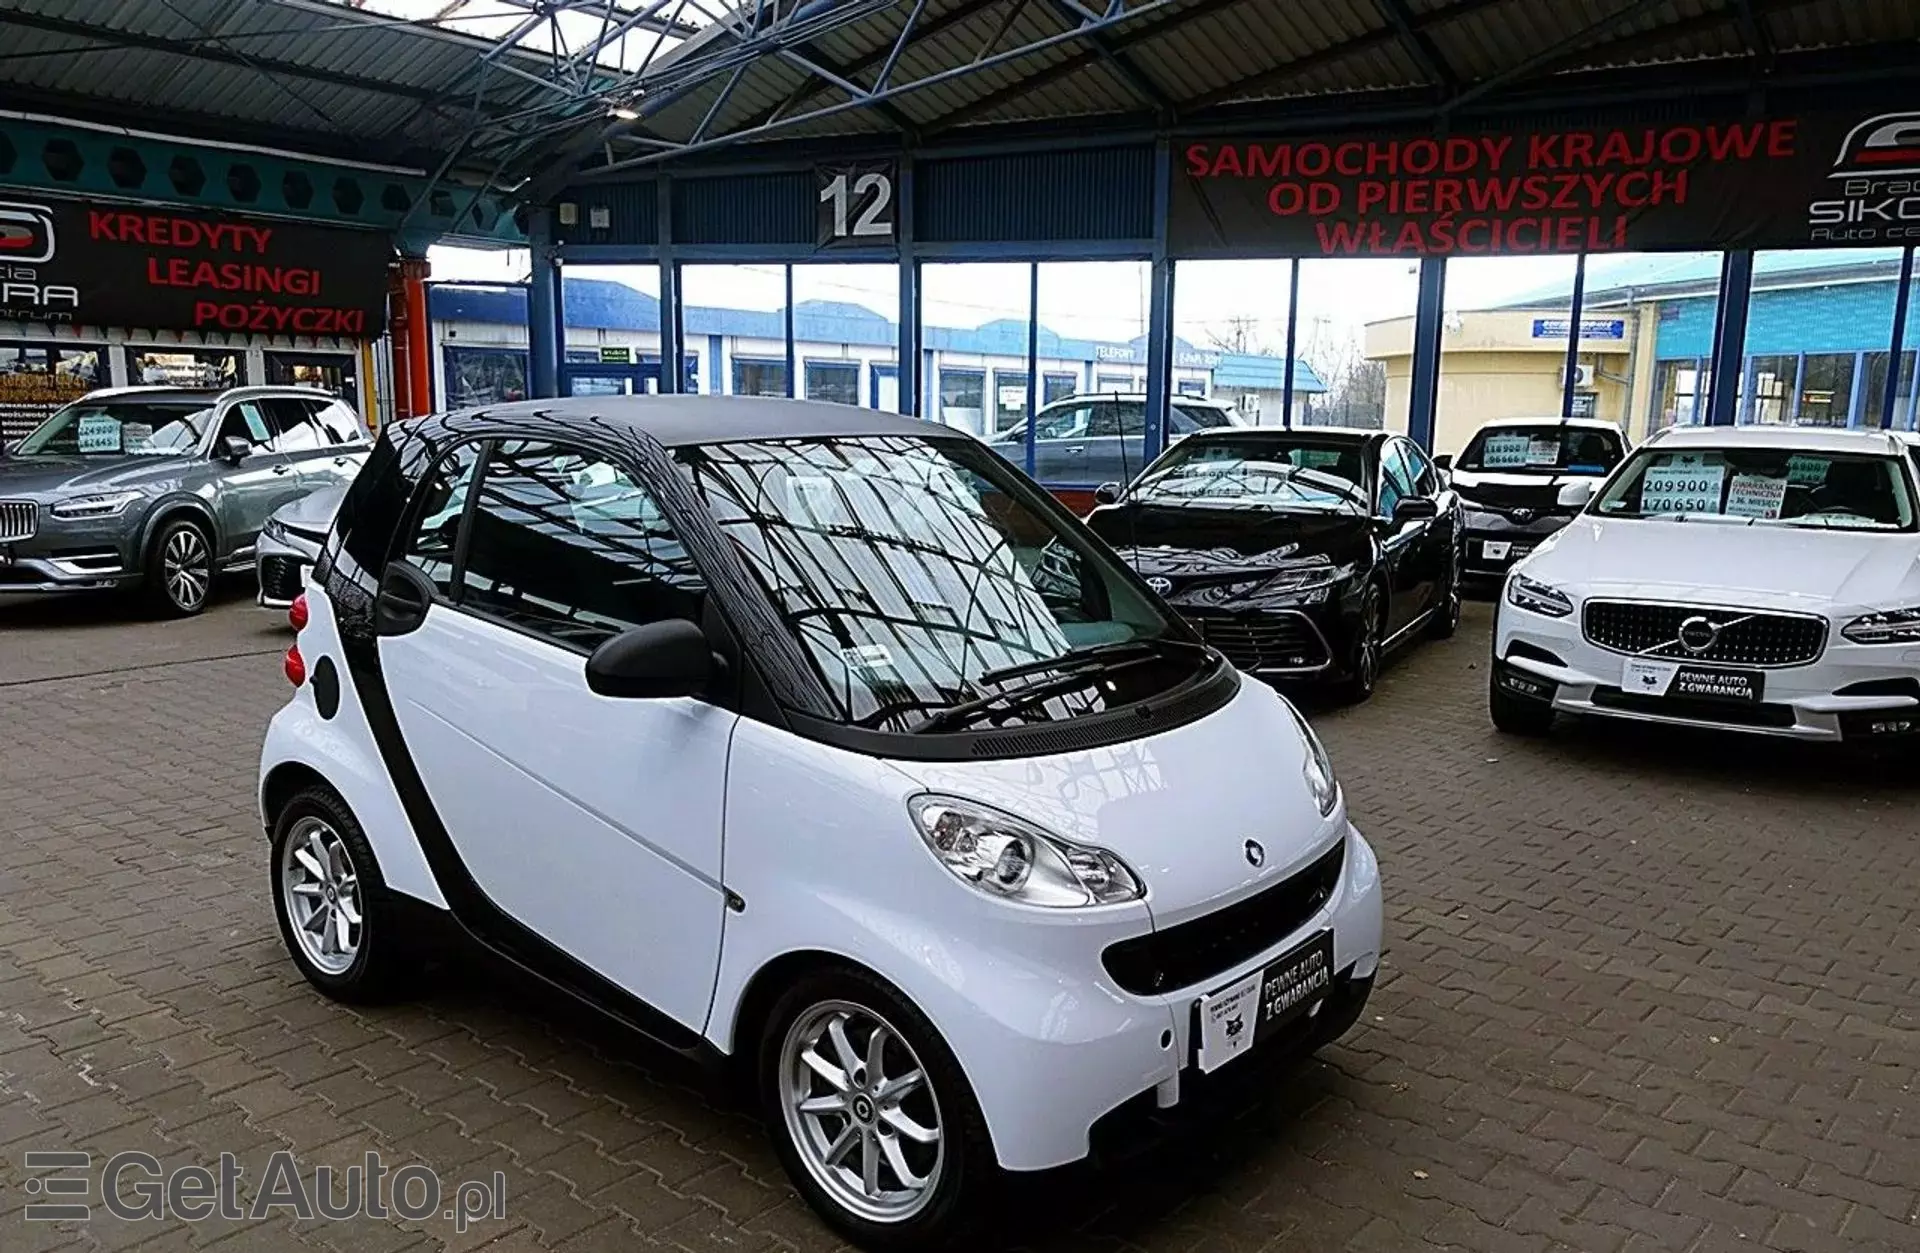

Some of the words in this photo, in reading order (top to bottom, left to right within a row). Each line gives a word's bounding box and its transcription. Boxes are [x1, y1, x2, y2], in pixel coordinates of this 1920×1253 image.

[1186, 135, 1513, 178] SAMOCHODY
[1527, 119, 1798, 169] KRAJOWE
[820, 173, 893, 237] 12
[1268, 180, 1342, 216] OD
[1358, 168, 1689, 214] PIERWSZYCH
[88, 209, 273, 254] KREDYTY
[1314, 210, 1629, 255] WŁAŚCICIELI
[1810, 228, 1877, 241] Auto
[146, 257, 320, 296] LEASINGI
[3, 283, 78, 306] RA
[194, 299, 366, 333] POŻYCZKI
[1644, 480, 1708, 492] 209900
[1643, 499, 1705, 511] 170650
[1679, 682, 1686, 691] Z
[1680, 672, 1715, 684] PEWNE
[1717, 675, 1748, 686] AUTO
[1264, 965, 1298, 1000] PEWNE
[1299, 949, 1323, 980] AUTO
[1266, 1002, 1273, 1020] Z
